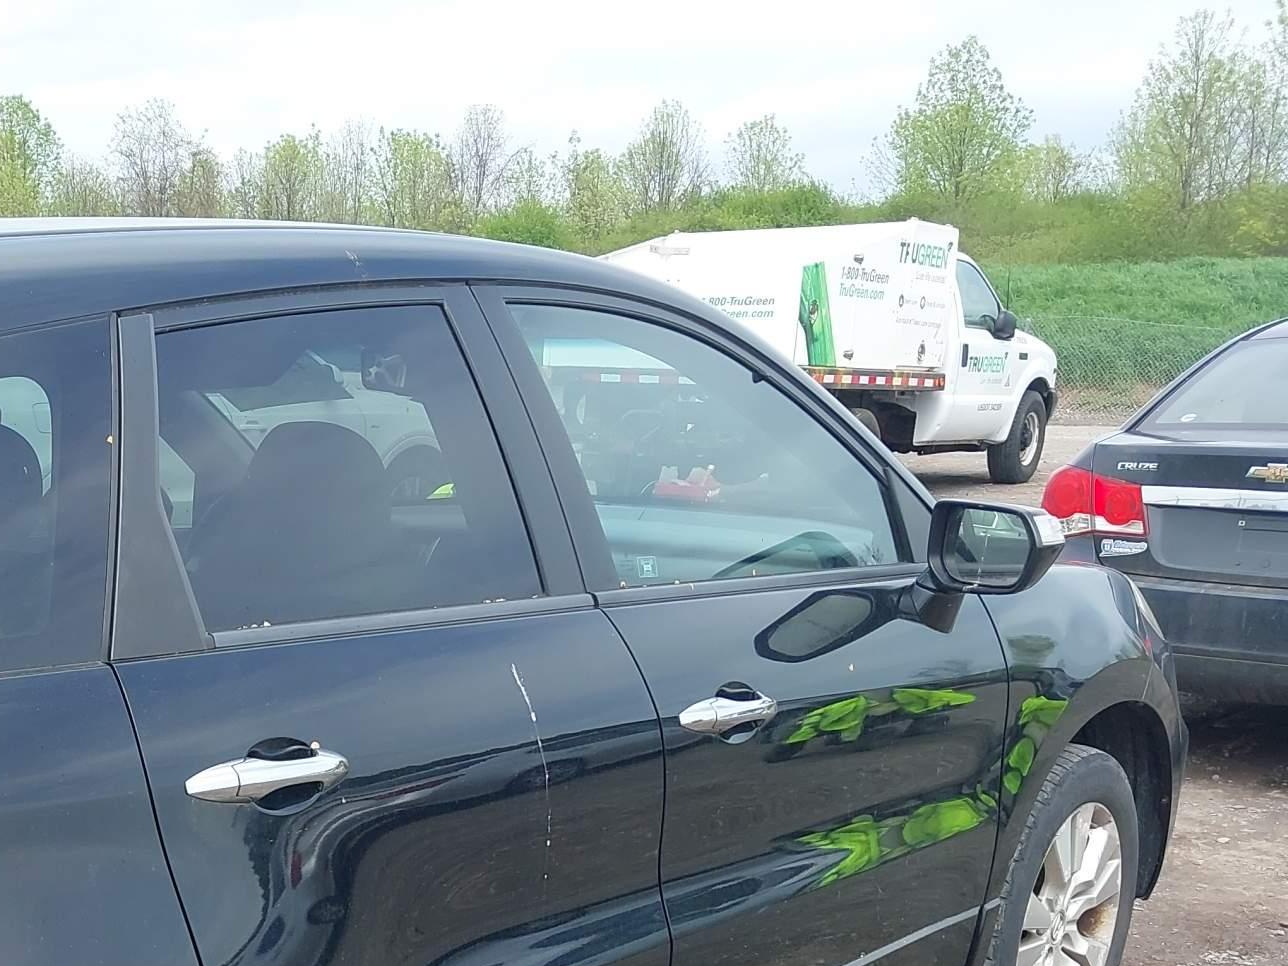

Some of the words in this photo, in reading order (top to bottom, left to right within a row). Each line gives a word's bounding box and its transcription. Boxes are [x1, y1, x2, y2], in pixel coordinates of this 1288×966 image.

[839, 283, 884, 300] TruGreen.com
[968, 355, 1006, 373] TRUGREEN
[1117, 461, 1159, 472] CRUZE
